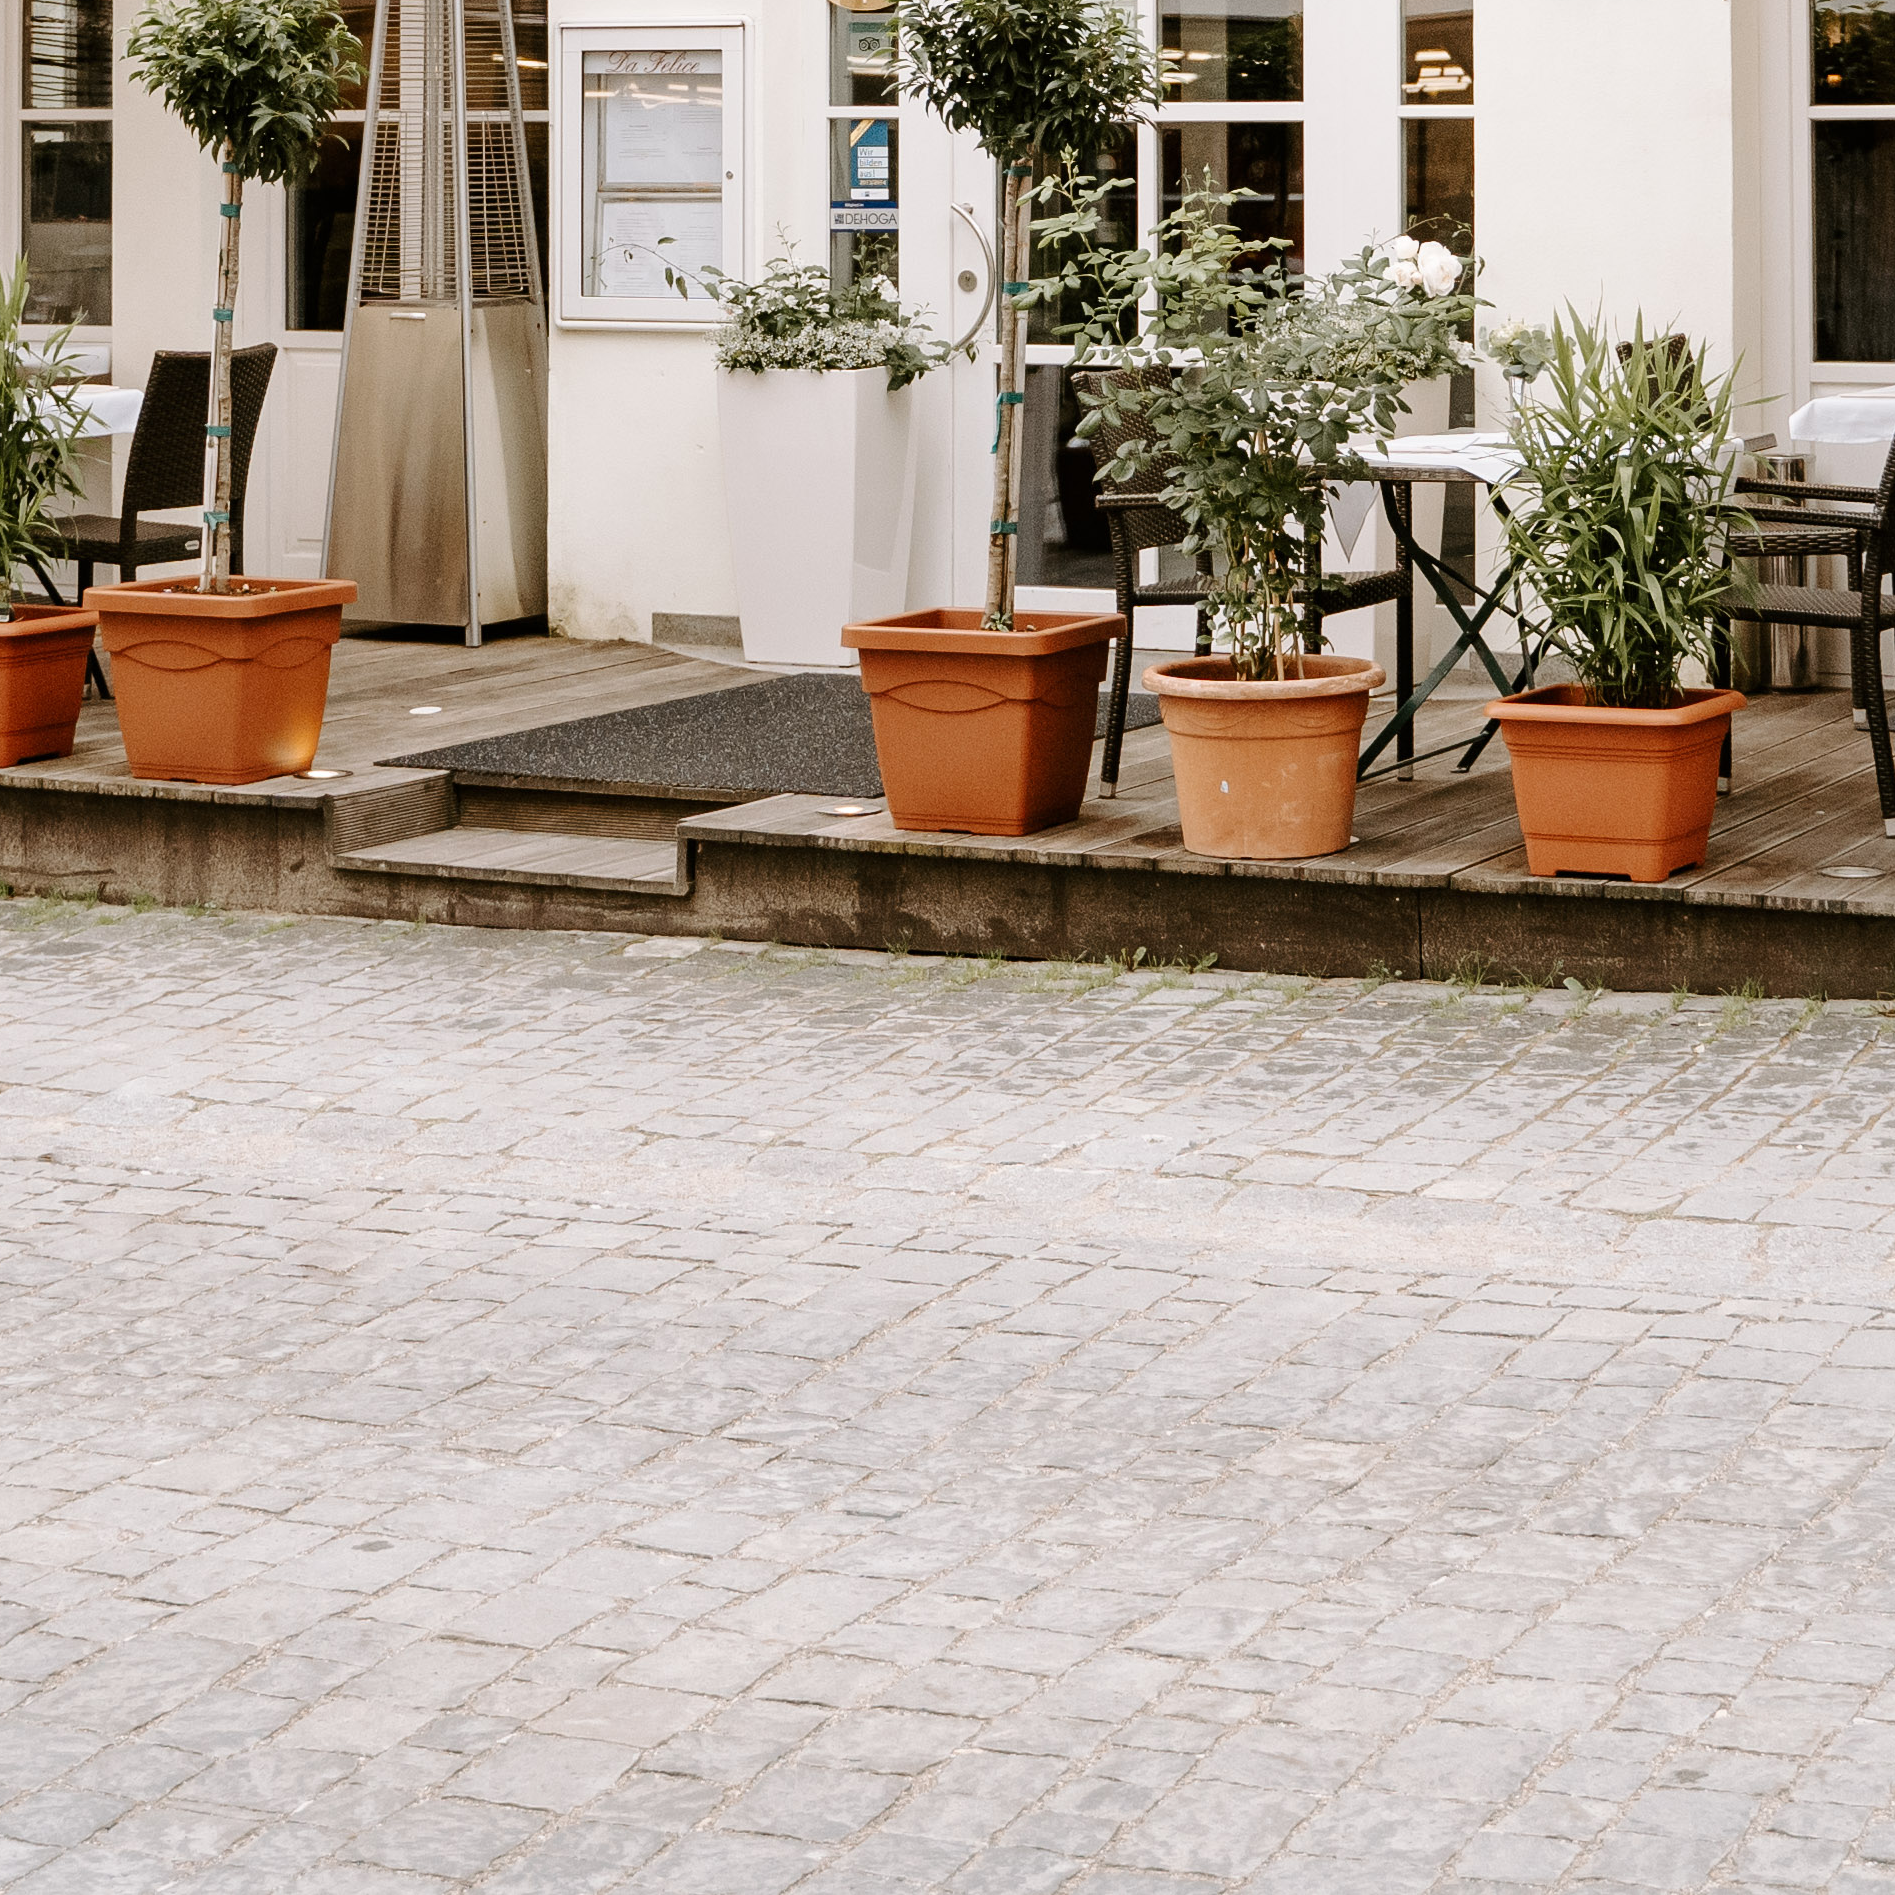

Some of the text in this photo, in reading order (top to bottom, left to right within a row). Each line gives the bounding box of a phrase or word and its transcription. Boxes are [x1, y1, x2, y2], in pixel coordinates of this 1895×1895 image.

[605, 51, 701, 74] Da Felice
[859, 148, 874, 156] Wir
[845, 212, 898, 225] DEHOGA
